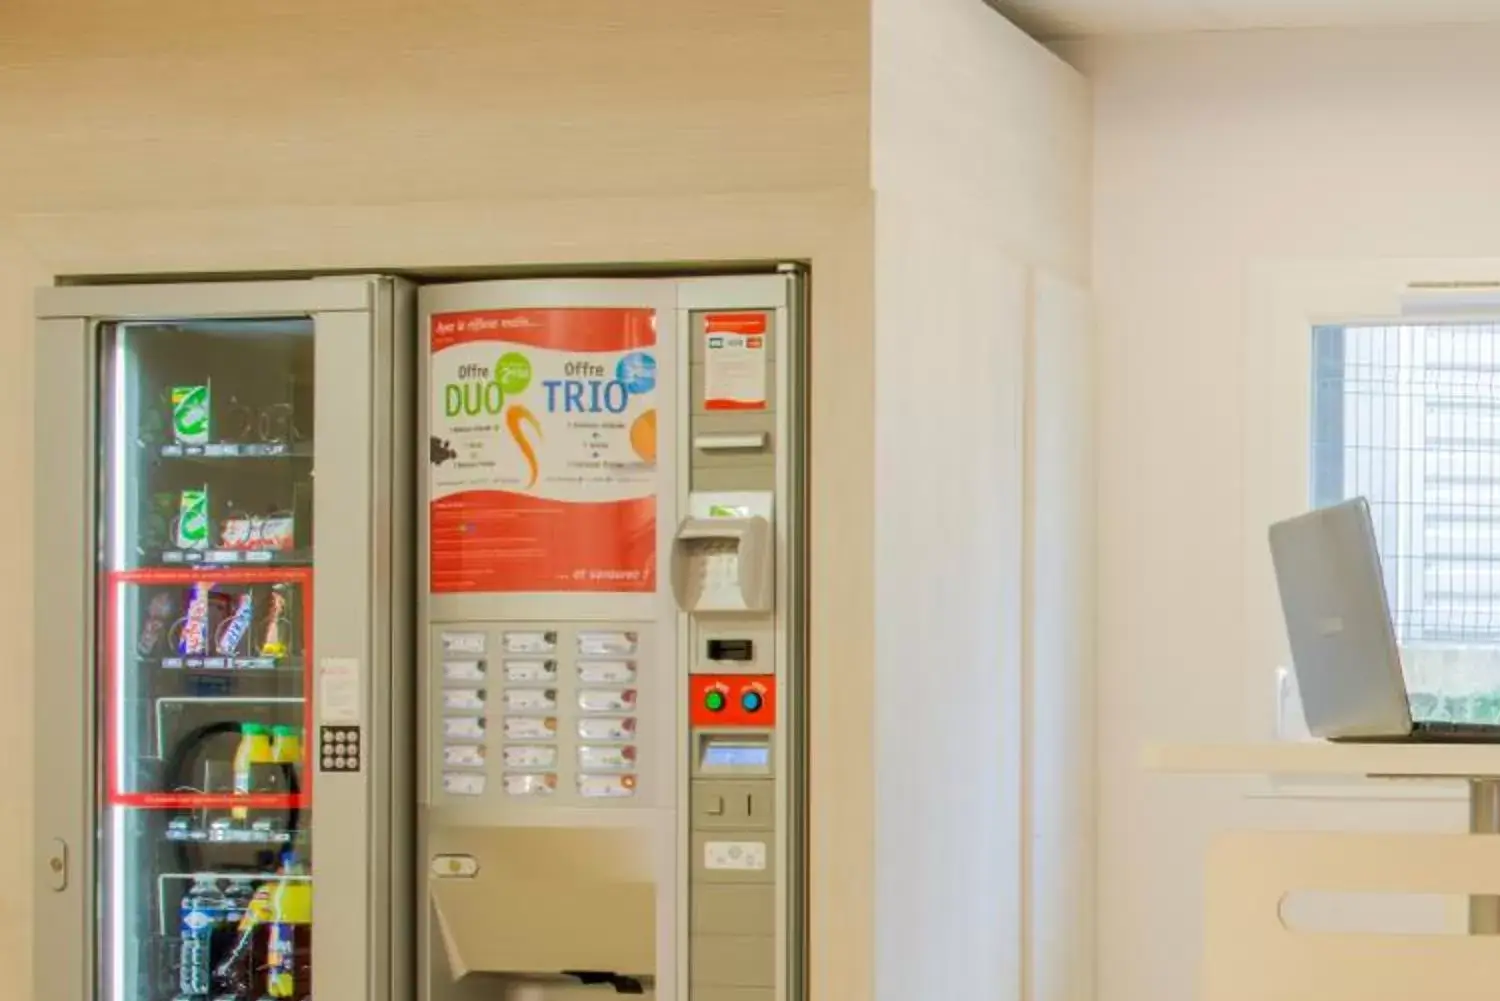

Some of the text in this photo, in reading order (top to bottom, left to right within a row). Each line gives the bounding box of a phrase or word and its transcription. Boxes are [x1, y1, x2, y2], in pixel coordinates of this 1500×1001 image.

[458, 363, 489, 379] Offre
[564, 361, 605, 377] Offre
[445, 381, 504, 417] DUO
[542, 380, 629, 414] TRIO
